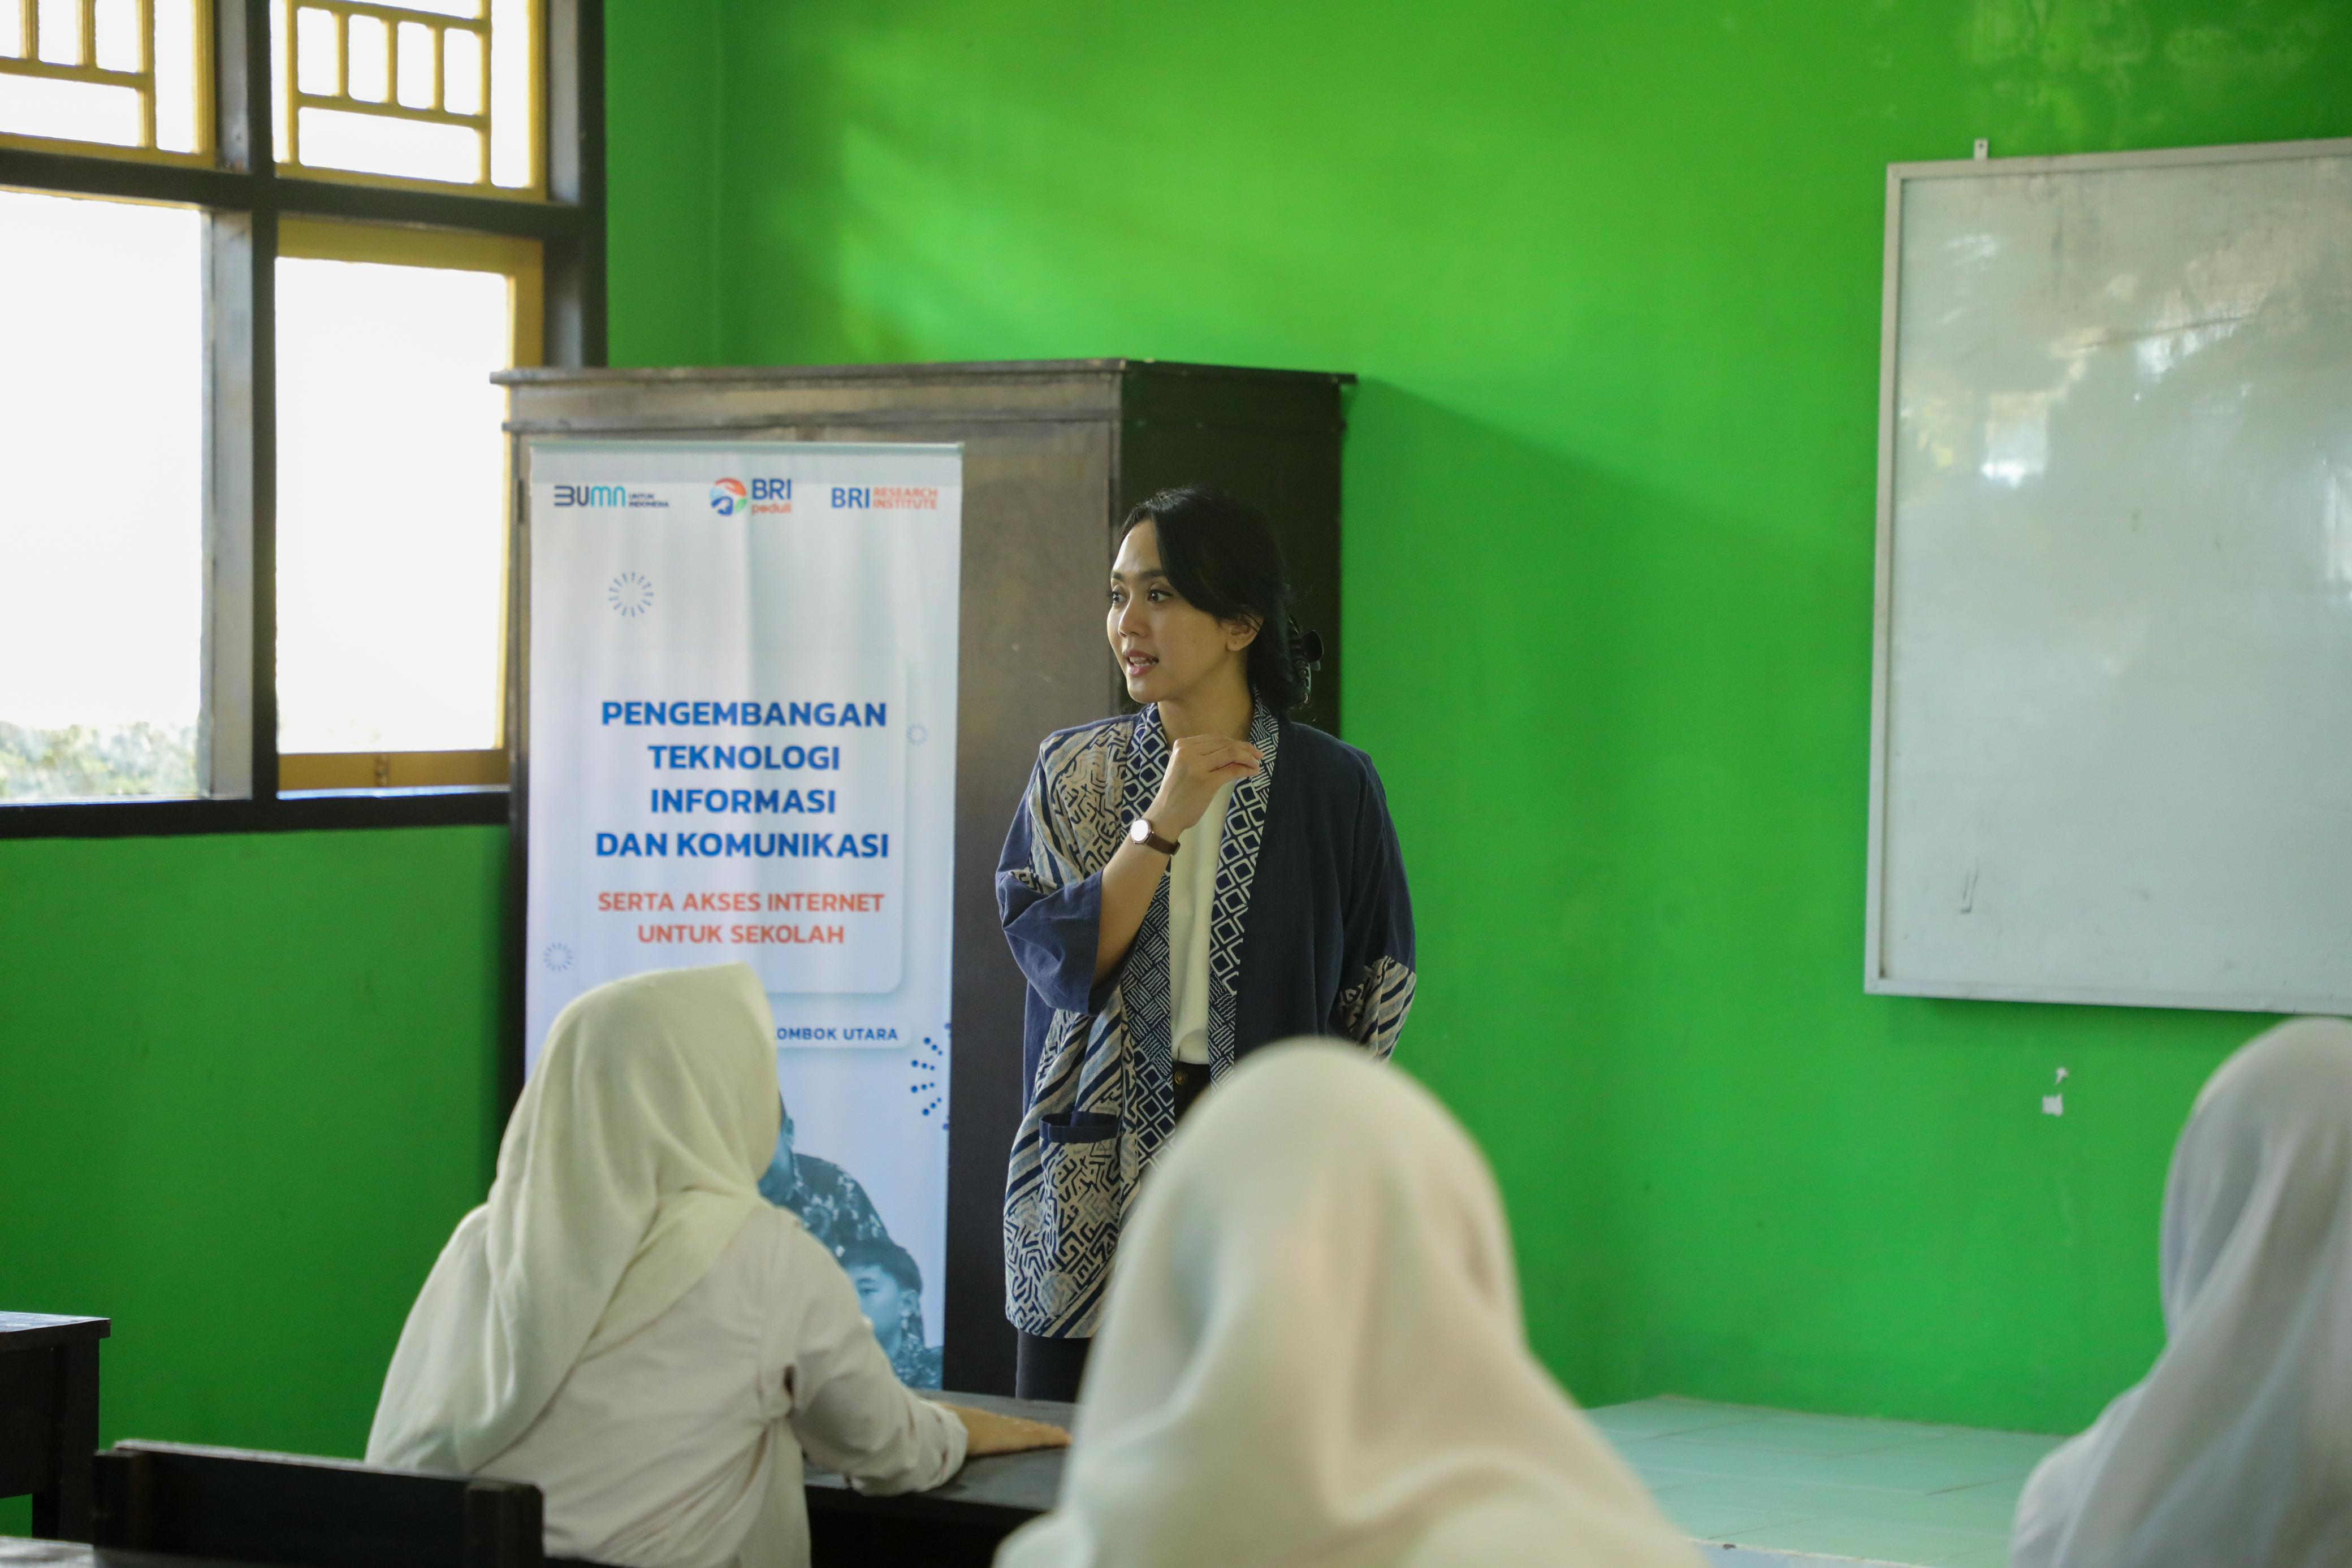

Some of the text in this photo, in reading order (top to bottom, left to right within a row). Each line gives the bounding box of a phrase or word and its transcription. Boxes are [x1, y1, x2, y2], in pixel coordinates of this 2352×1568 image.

[751, 478, 792, 500] BRI
[831, 487, 870, 509] BRI
[873, 487, 939, 499] RESEARCH
[751, 502, 792, 516] peduli
[873, 499, 938, 510] INSTITUTE
[601, 701, 887, 727] PENGEMBANGAN
[647, 744, 840, 770] TEKNOLOGI
[650, 789, 836, 814] INFORMASI
[595, 832, 889, 858] DAN KOMUNIKASI
[597, 891, 885, 912] SERTA AKSES INTERNET
[637, 924, 845, 944] UNTUK SEKOLAH
[774, 1028, 899, 1041] OMBOK UTARA
